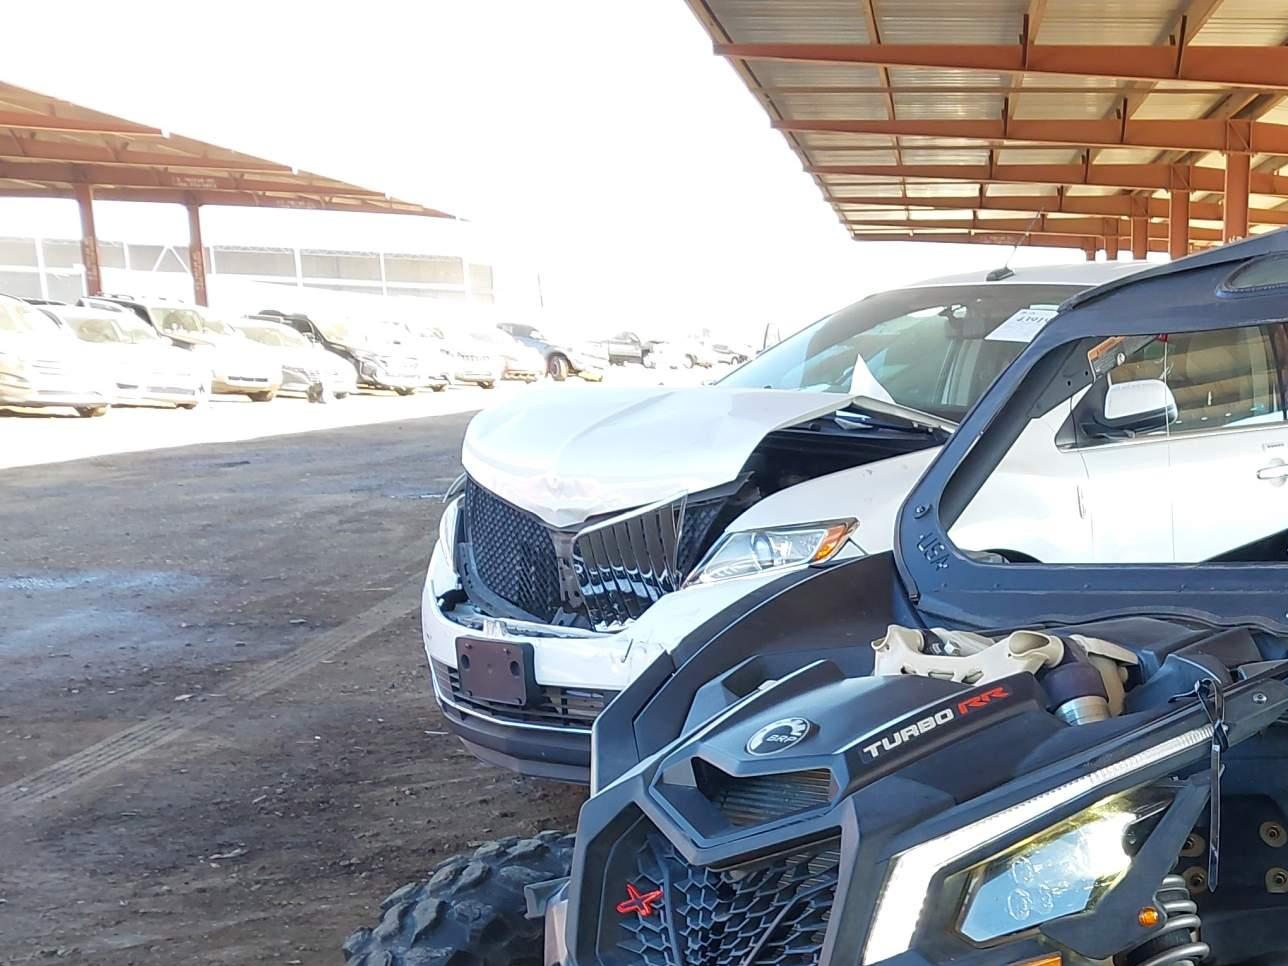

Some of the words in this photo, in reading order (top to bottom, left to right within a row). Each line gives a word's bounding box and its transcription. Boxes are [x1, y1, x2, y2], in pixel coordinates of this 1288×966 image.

[766, 734, 798, 744] BRP
[862, 707, 955, 758] TURBO
[957, 686, 1010, 716] RR
